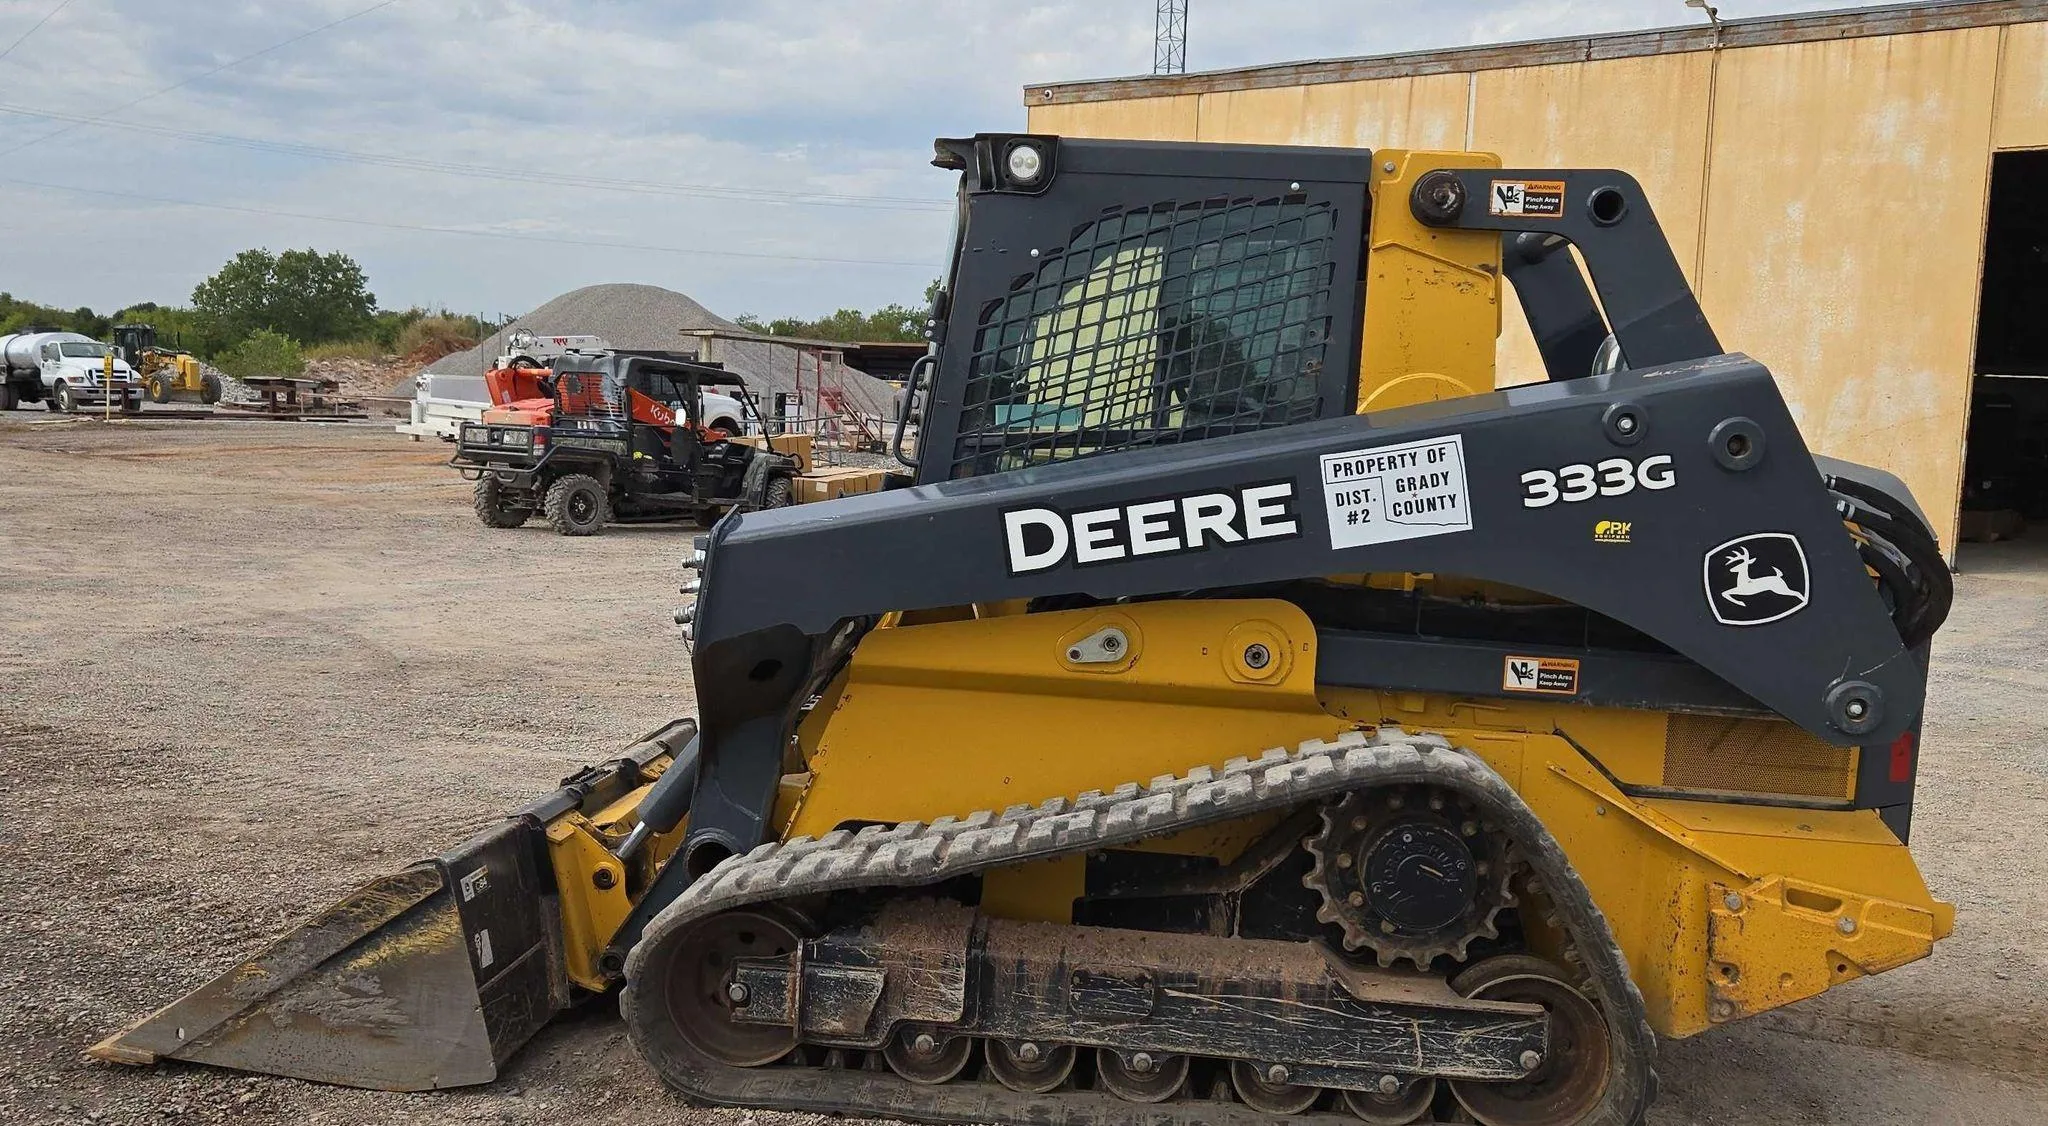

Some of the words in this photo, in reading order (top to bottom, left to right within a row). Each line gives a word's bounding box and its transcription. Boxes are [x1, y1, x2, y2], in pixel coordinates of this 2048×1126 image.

[1332, 451, 1418, 478] PROPERTY
[1427, 446, 1447, 464] OF
[1396, 470, 1450, 493] GRADY
[1521, 455, 1676, 508] 333G
[1335, 488, 1377, 507] DIST.
[1392, 493, 1457, 518] COUNTY
[1004, 483, 1298, 573] DEERE
[1347, 508, 1371, 526] #2
